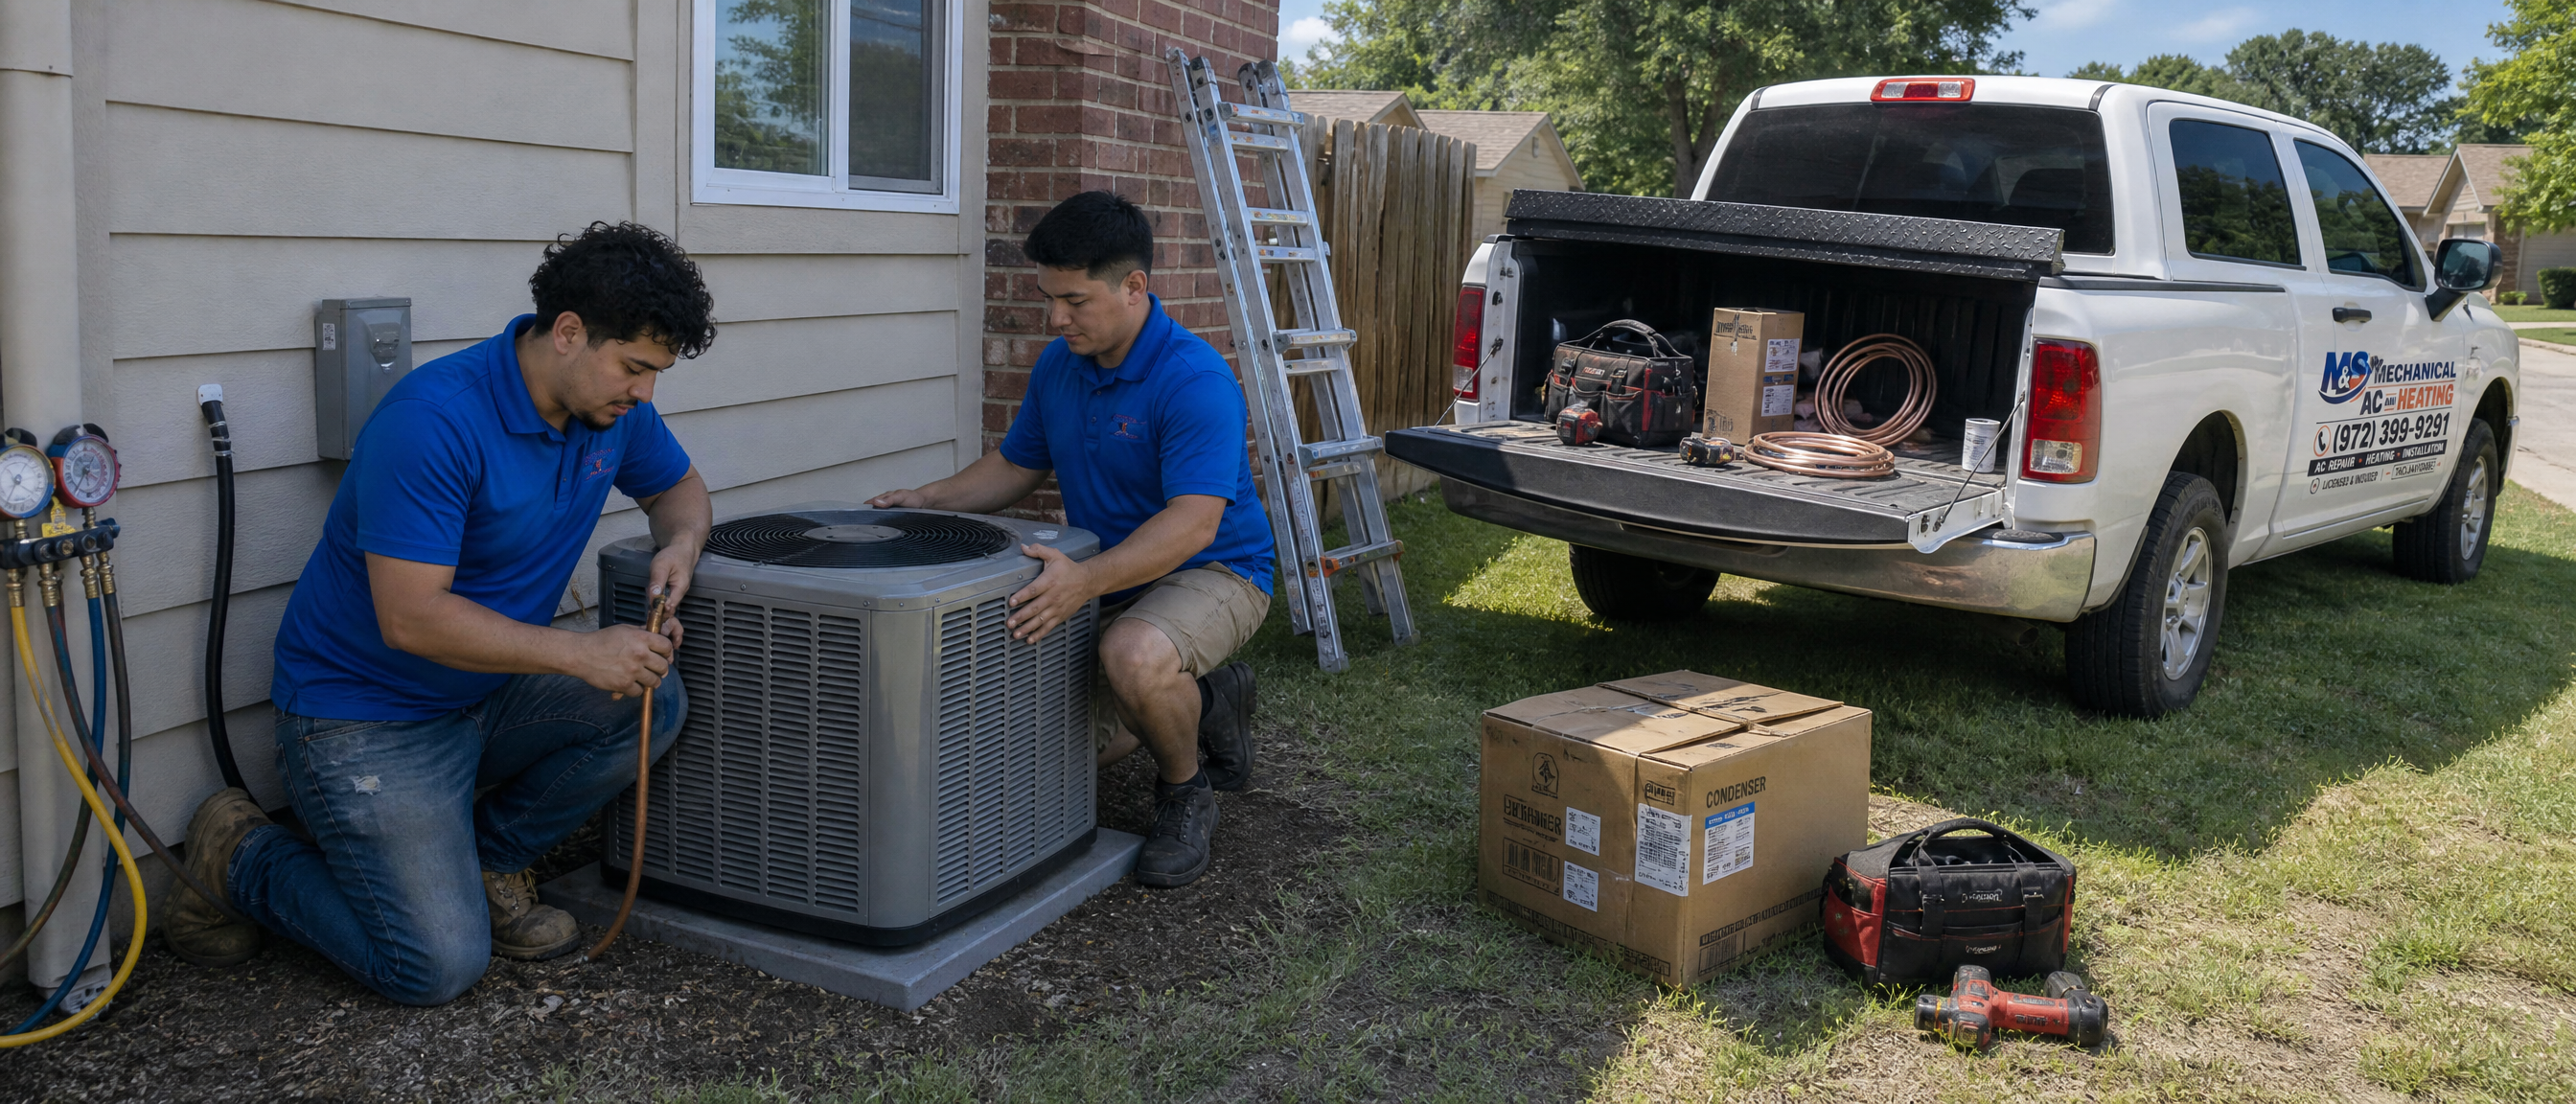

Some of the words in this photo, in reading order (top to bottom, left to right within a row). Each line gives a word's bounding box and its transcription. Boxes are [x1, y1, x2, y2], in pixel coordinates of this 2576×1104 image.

[2319, 351, 2372, 395] M&S
[2374, 360, 2456, 383] MECHANICAL
[2359, 389, 2383, 415] AC
[2397, 384, 2454, 410] HEATING
[2334, 420, 2377, 453] (972)
[2379, 412, 2450, 446] 399-9291
[2314, 463, 2326, 473] AC
[2365, 450, 2396, 466] HEATING
[1706, 776, 1766, 808] CONDENSER
